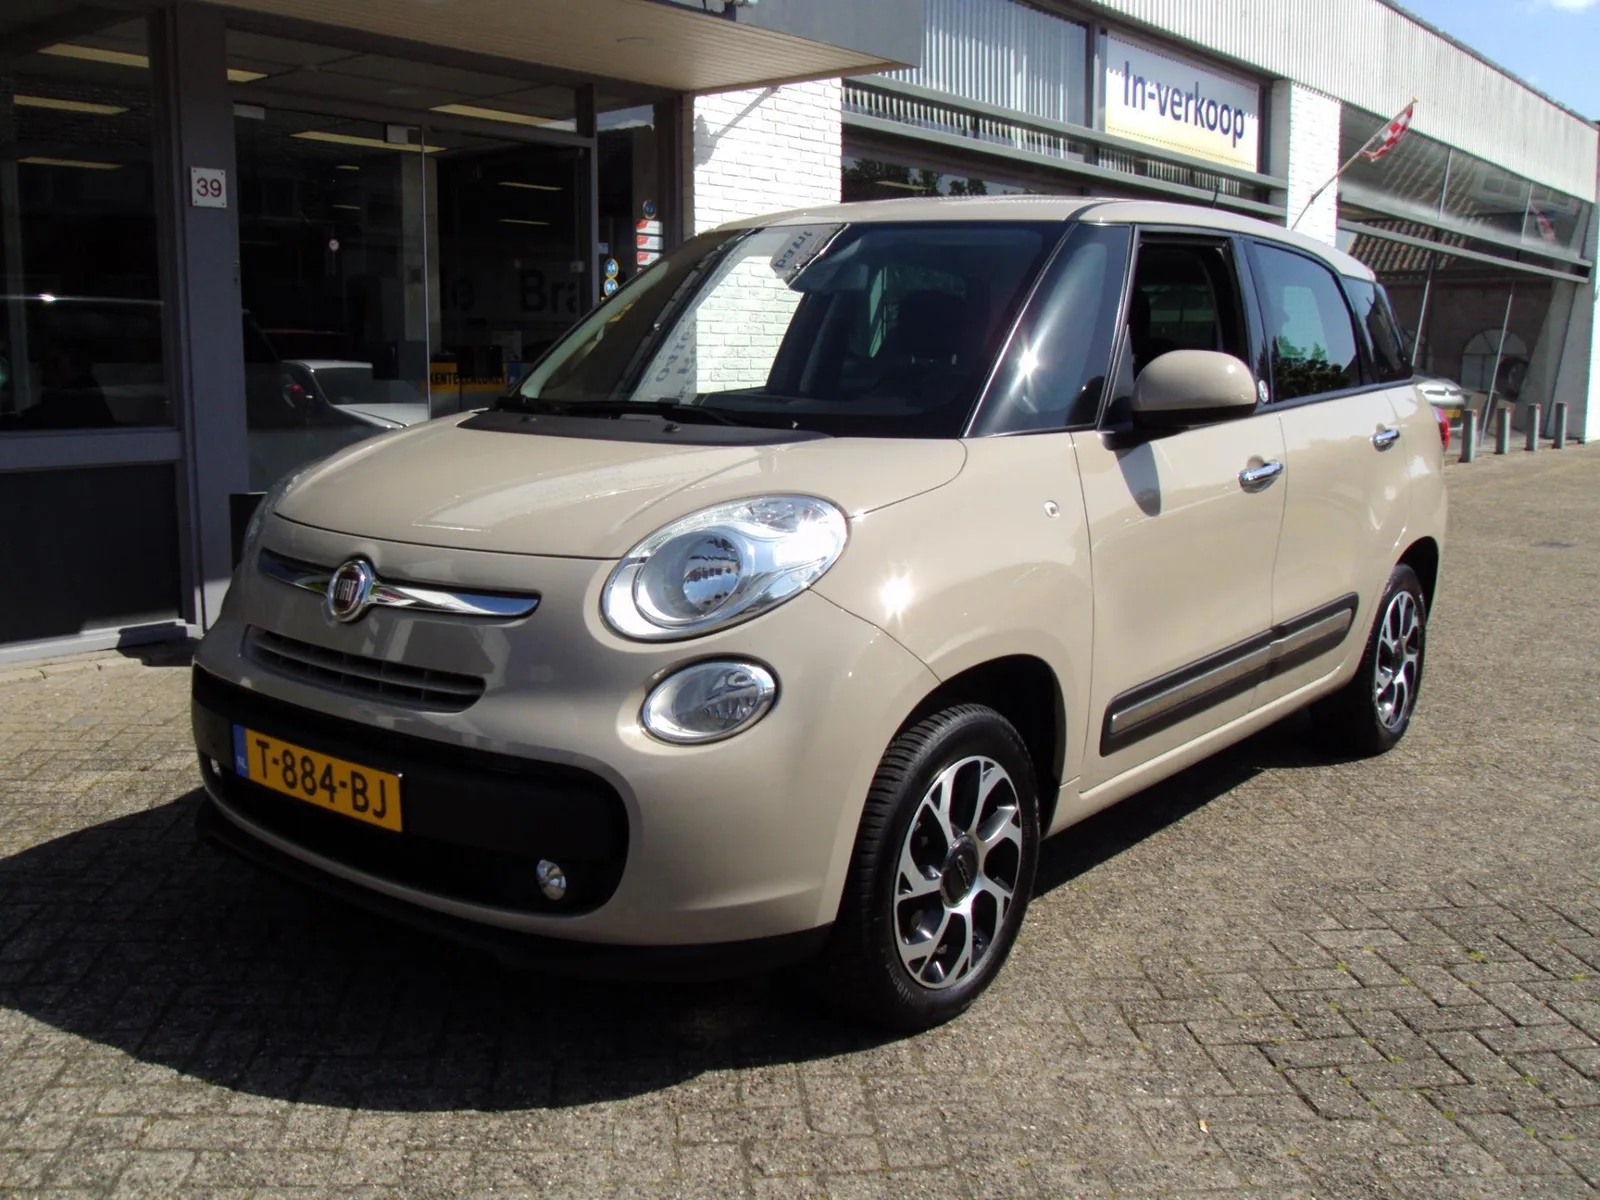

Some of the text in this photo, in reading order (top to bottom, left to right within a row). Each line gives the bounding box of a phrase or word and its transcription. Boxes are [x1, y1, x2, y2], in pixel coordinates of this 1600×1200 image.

[1124, 60, 1245, 148] In-verkoop
[196, 177, 222, 198] 39
[335, 578, 358, 601] FIAT
[236, 755, 247, 769] NL
[255, 739, 387, 819] T-884-BJ
